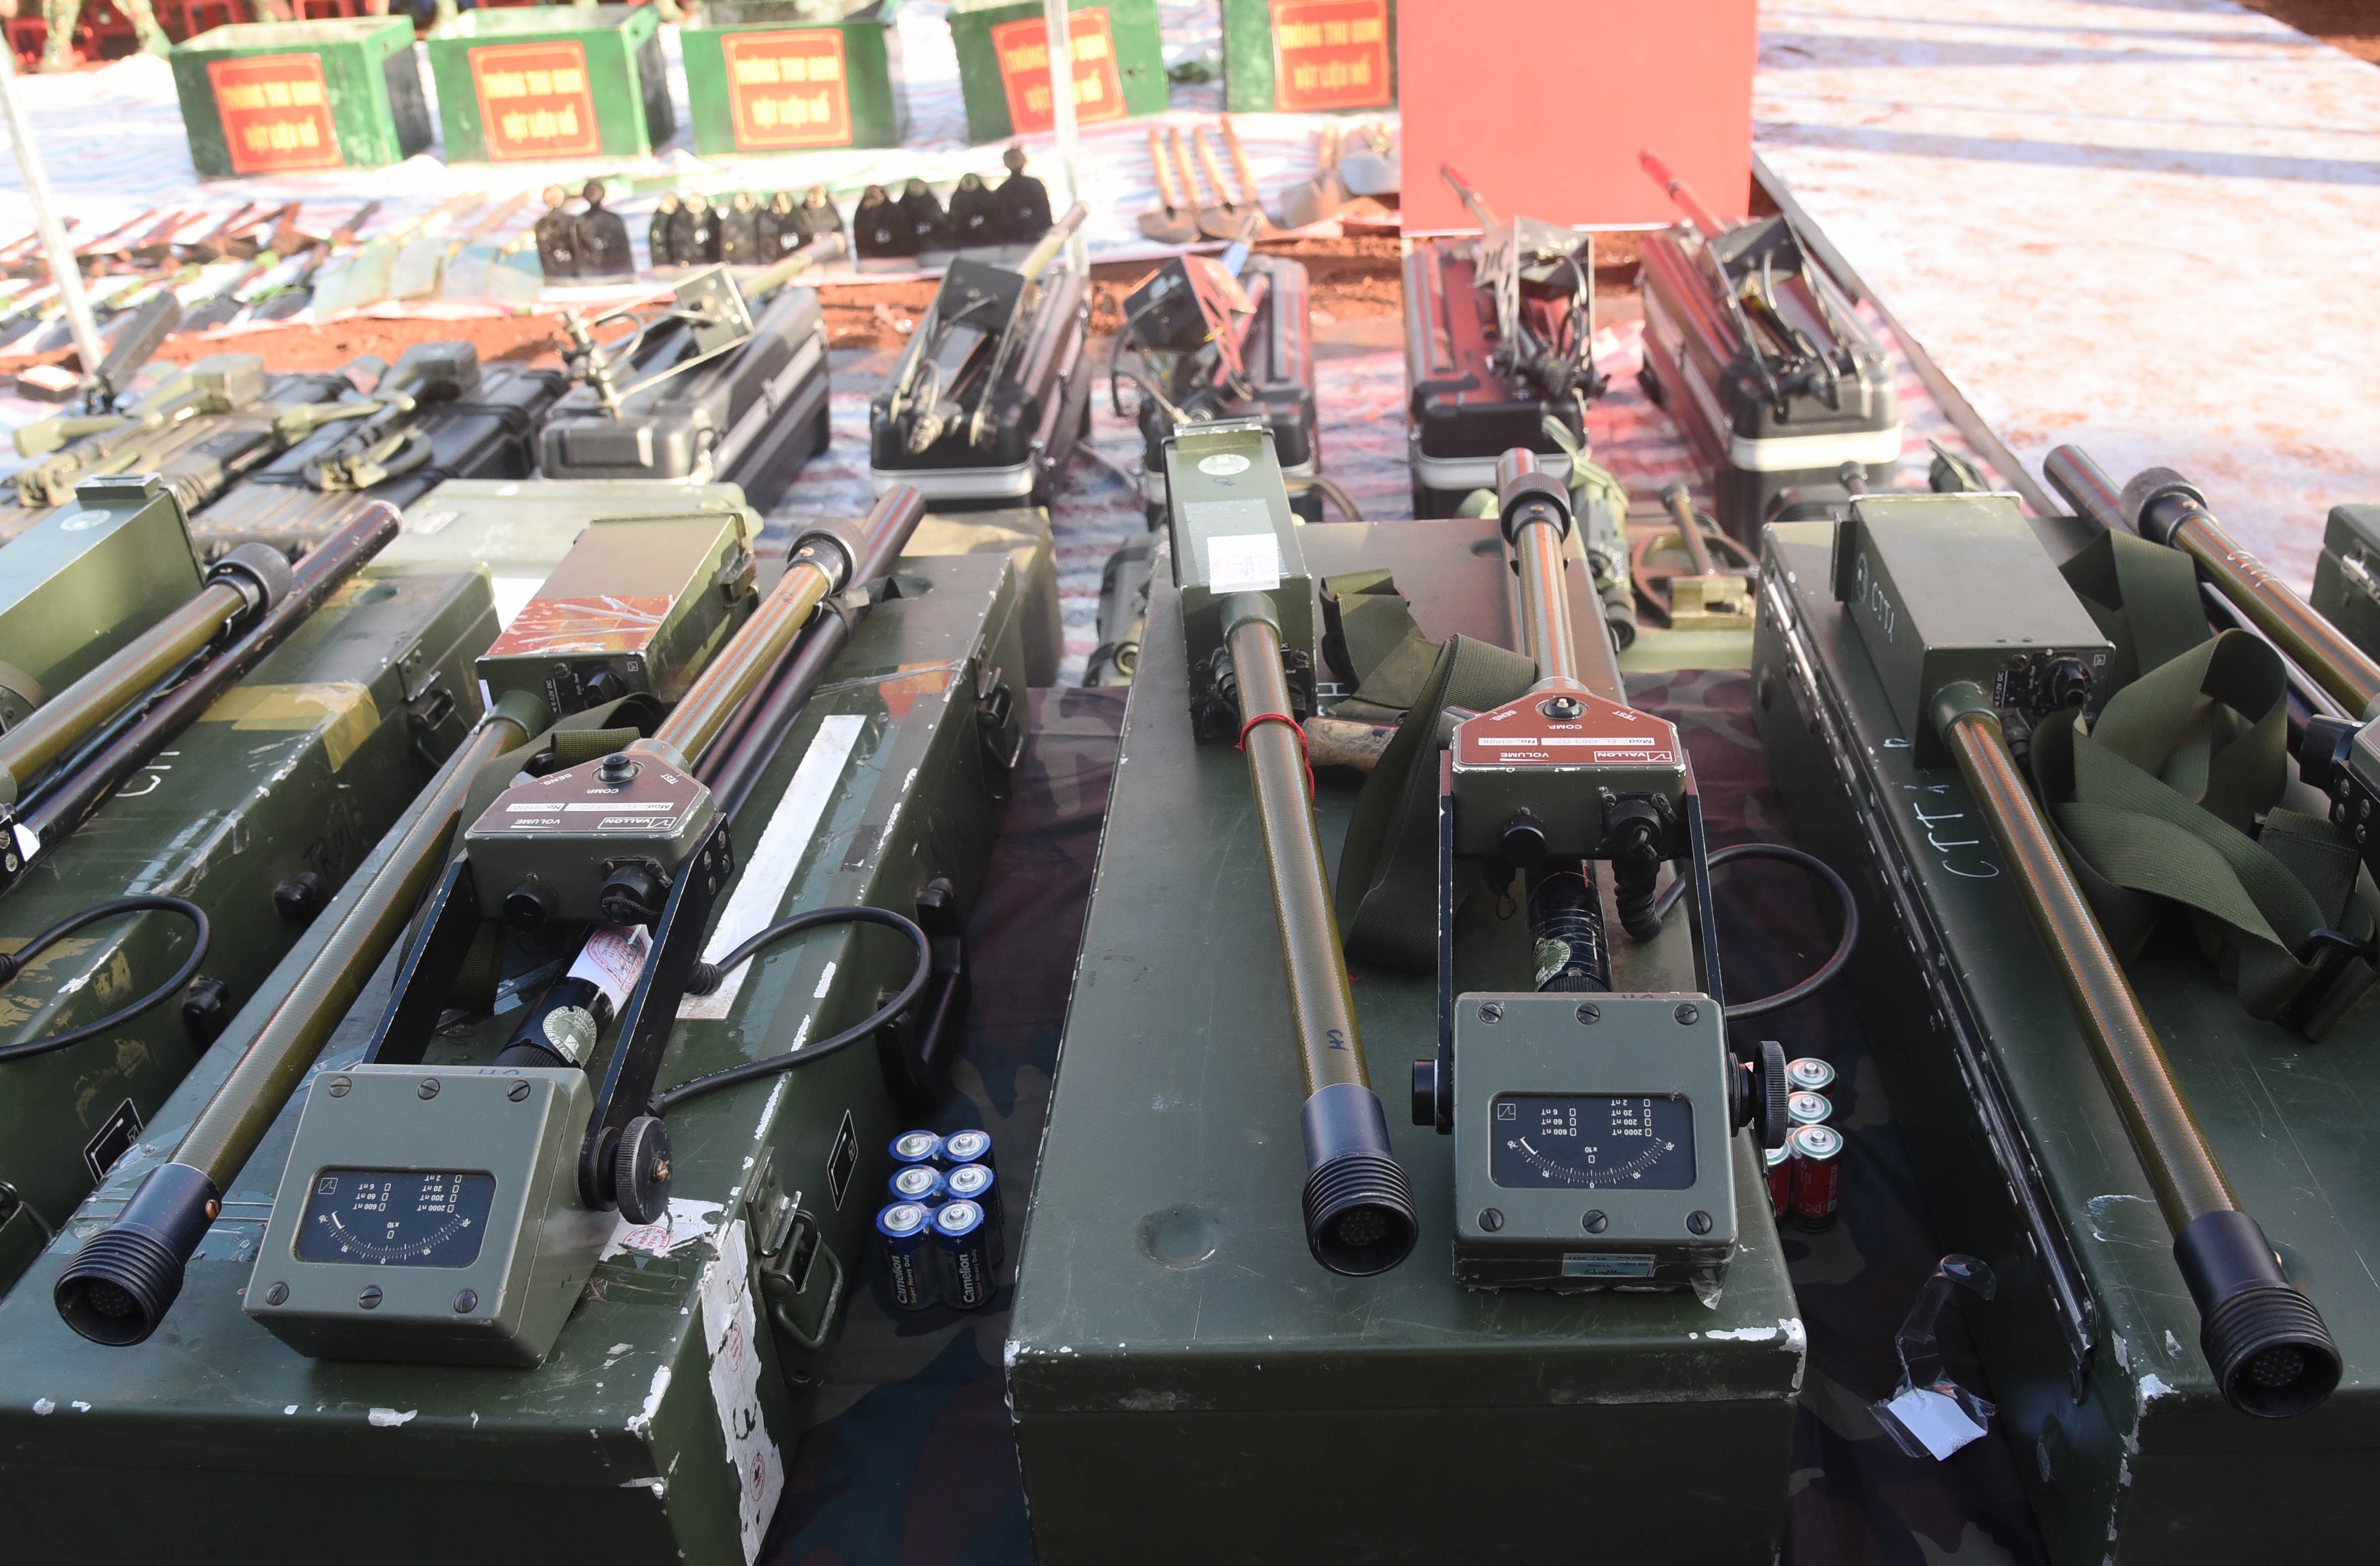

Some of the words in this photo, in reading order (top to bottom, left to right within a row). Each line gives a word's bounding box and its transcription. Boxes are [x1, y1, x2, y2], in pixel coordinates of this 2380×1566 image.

[1489, 709, 1517, 721] SENS.
[1612, 710, 1637, 721] TEST
[540, 773, 573, 786] SENS.
[660, 773, 679, 785] TEST
[1507, 1140, 1517, 1149] 20
[1665, 1141, 1674, 1151] 20
[1542, 1169, 1550, 1178] 10
[1632, 1171, 1641, 1179] 10
[461, 1218, 471, 1227] 20
[341, 1245, 349, 1253] 10
[423, 1248, 431, 1256] 10
[891, 1255, 908, 1304] Camelion
[907, 1268, 915, 1286] Heavy
[959, 1254, 975, 1303] Camelion
